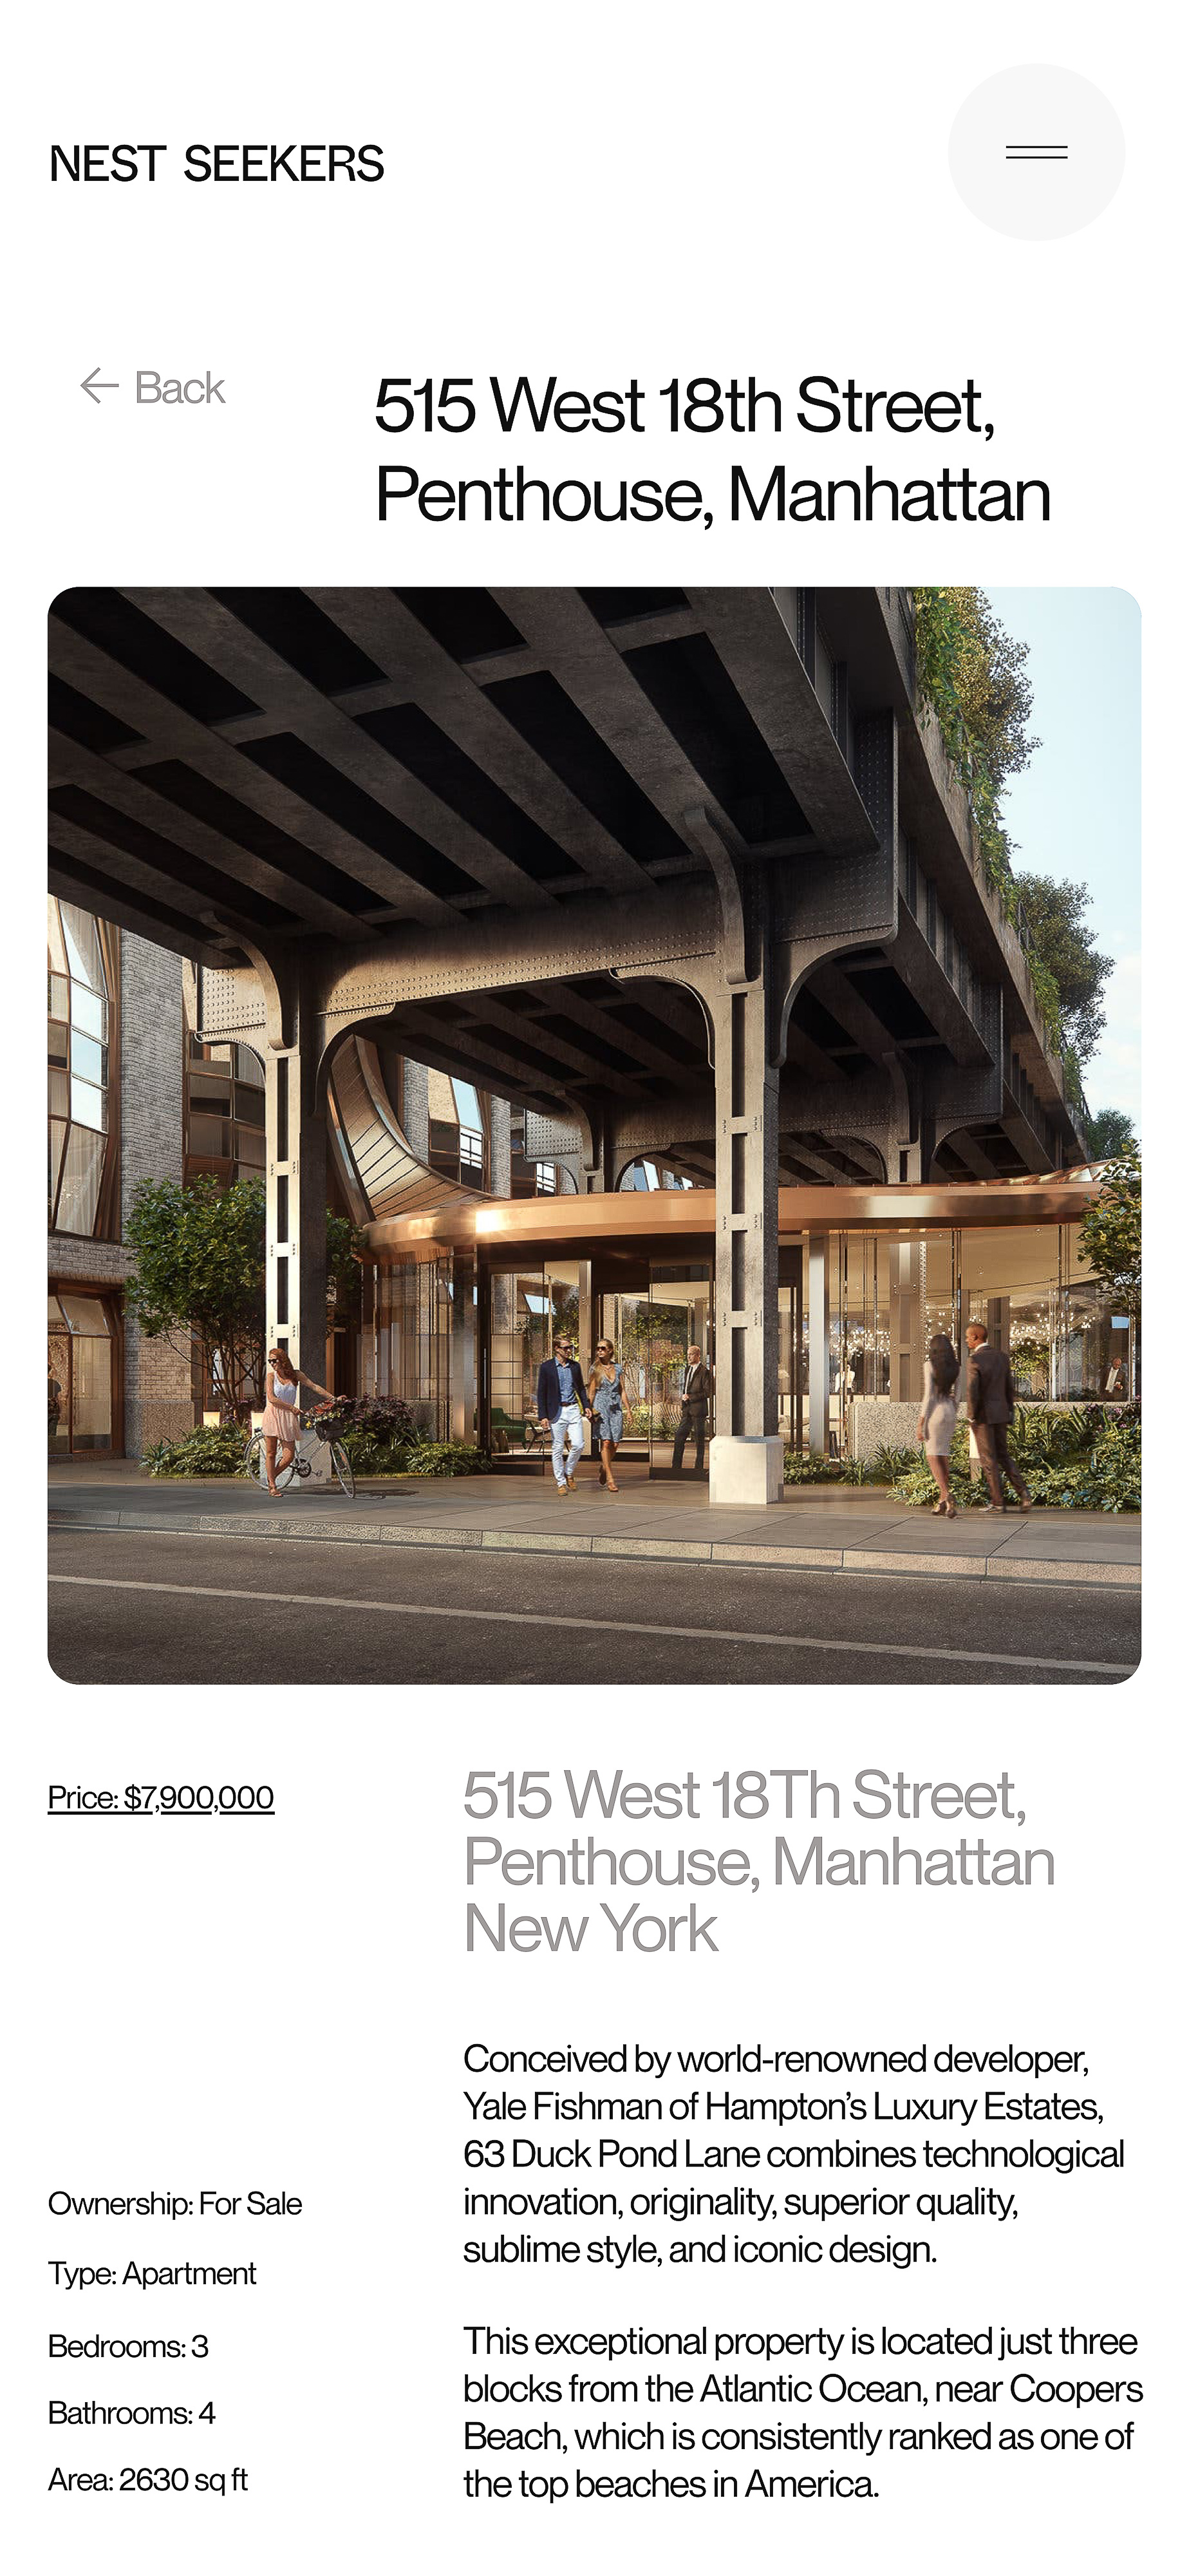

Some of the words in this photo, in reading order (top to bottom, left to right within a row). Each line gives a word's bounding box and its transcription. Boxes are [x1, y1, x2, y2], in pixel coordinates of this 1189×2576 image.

[51, 144, 167, 182] NEST
[184, 144, 384, 182] SEEKERS
[137, 371, 226, 404] Back
[376, 379, 476, 433] 515
[489, 377, 645, 433] West
[660, 377, 781, 433] 18th
[797, 376, 994, 441] Street,
[379, 466, 713, 530] Penthouse,
[731, 466, 1049, 522] Manhattan
[50, 1785, 118, 1808] Price:
[124, 1784, 274, 1812] $7,900,000
[465, 1772, 552, 1819] 515
[564, 1770, 700, 1819] West
[713, 1770, 839, 1819] 18Th
[854, 1769, 1025, 1826] Street,
[467, 1837, 759, 1893] Penthouse,
[776, 1837, 1054, 1886] Manhattan
[467, 1904, 589, 1952] New
[600, 1904, 719, 1952] York
[464, 2043, 626, 2072] Conceived
[635, 2044, 671, 2078] by
[677, 2044, 926, 2072] world-renowned
[934, 2044, 1088, 2078] developer,
[463, 2092, 526, 2120] Yale
[535, 2092, 662, 2120] Fishman
[669, 2092, 698, 2120] of
[707, 2092, 866, 2126] Hampton’s
[875, 2092, 978, 2126] Luxury
[986, 2092, 1103, 2124] Estates,
[465, 2140, 505, 2168] 63
[513, 2139, 592, 2168] Duck
[600, 2139, 677, 2168] Pond
[686, 2139, 760, 2168] Lane
[767, 2139, 916, 2168] combines
[923, 2139, 1123, 2174] technological
[49, 2191, 192, 2220] Ownership:
[201, 2192, 241, 2215] For
[247, 2191, 302, 2215] Sale
[465, 2188, 623, 2219] innovation,
[631, 2187, 777, 2221] originality,
[784, 2188, 910, 2221] superior
[917, 2187, 1018, 2221] quality,
[463, 2235, 580, 2262] sublime
[587, 2235, 662, 2269] style,
[669, 2235, 726, 2262] and
[735, 2235, 823, 2262] iconic
[829, 2235, 937, 2269] design.
[48, 2261, 116, 2289] Type:
[122, 2261, 256, 2289] Apartment
[50, 2334, 185, 2358] Bedrooms:
[192, 2334, 209, 2358] 3
[463, 2327, 529, 2354] This
[535, 2327, 706, 2361] exceptional
[715, 2328, 845, 2361] property
[852, 2327, 874, 2354] is
[883, 2327, 992, 2354] located
[998, 2327, 1052, 2361] just
[1059, 2327, 1138, 2354] three
[465, 2374, 562, 2402] blocks
[568, 2374, 637, 2402] from
[645, 2374, 693, 2402] the
[700, 2374, 812, 2402] Atlantic
[819, 2374, 928, 2407] Ocean,
[937, 2382, 1004, 2402] near
[1011, 2374, 1143, 2409] Coopers
[50, 2401, 192, 2424] Bathrooms:
[199, 2401, 216, 2424] 4
[465, 2421, 567, 2454] Beach,
[574, 2421, 664, 2450] which
[673, 2422, 695, 2450] is
[702, 2421, 883, 2456] consistently
[890, 2421, 991, 2450] ranked
[999, 2429, 1034, 2450] as
[1041, 2429, 1098, 2450] one
[1105, 2421, 1134, 2450] of
[48, 2468, 113, 2491] Area:
[120, 2468, 189, 2491] 2630
[195, 2474, 225, 2496] sq
[231, 2467, 248, 2490] ft
[463, 2469, 512, 2497] the
[519, 2470, 568, 2503] top
[577, 2469, 706, 2497] beaches
[714, 2470, 737, 2497] in
[745, 2469, 879, 2497] America.
